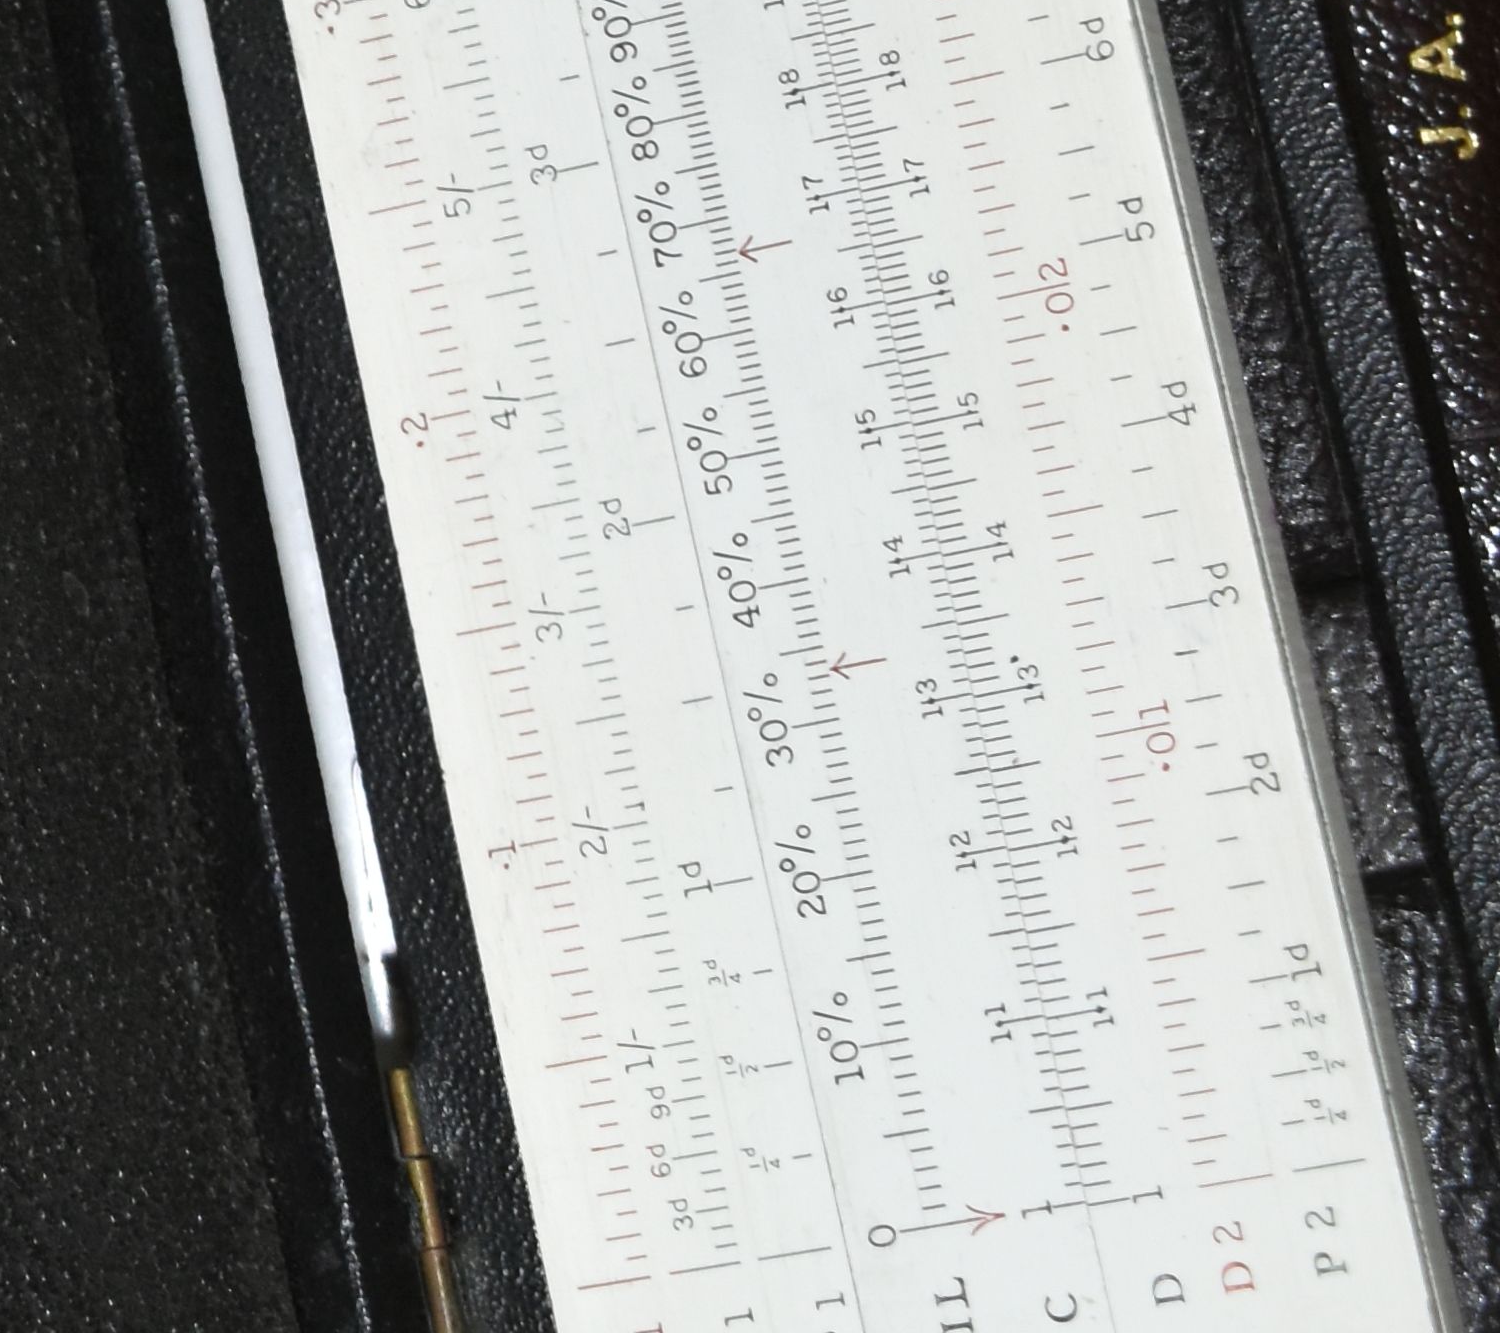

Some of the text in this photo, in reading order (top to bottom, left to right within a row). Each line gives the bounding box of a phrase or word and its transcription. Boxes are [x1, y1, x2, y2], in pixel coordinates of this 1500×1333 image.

[614, 75, 660, 161] 80%
[634, 180, 683, 268] 70%
[660, 289, 708, 378] 60%
[682, 405, 733, 496] 50%
[713, 531, 761, 629] 40%
[743, 671, 795, 767] 30%
[774, 823, 827, 919] 20%
[811, 990, 865, 1085] 10%
